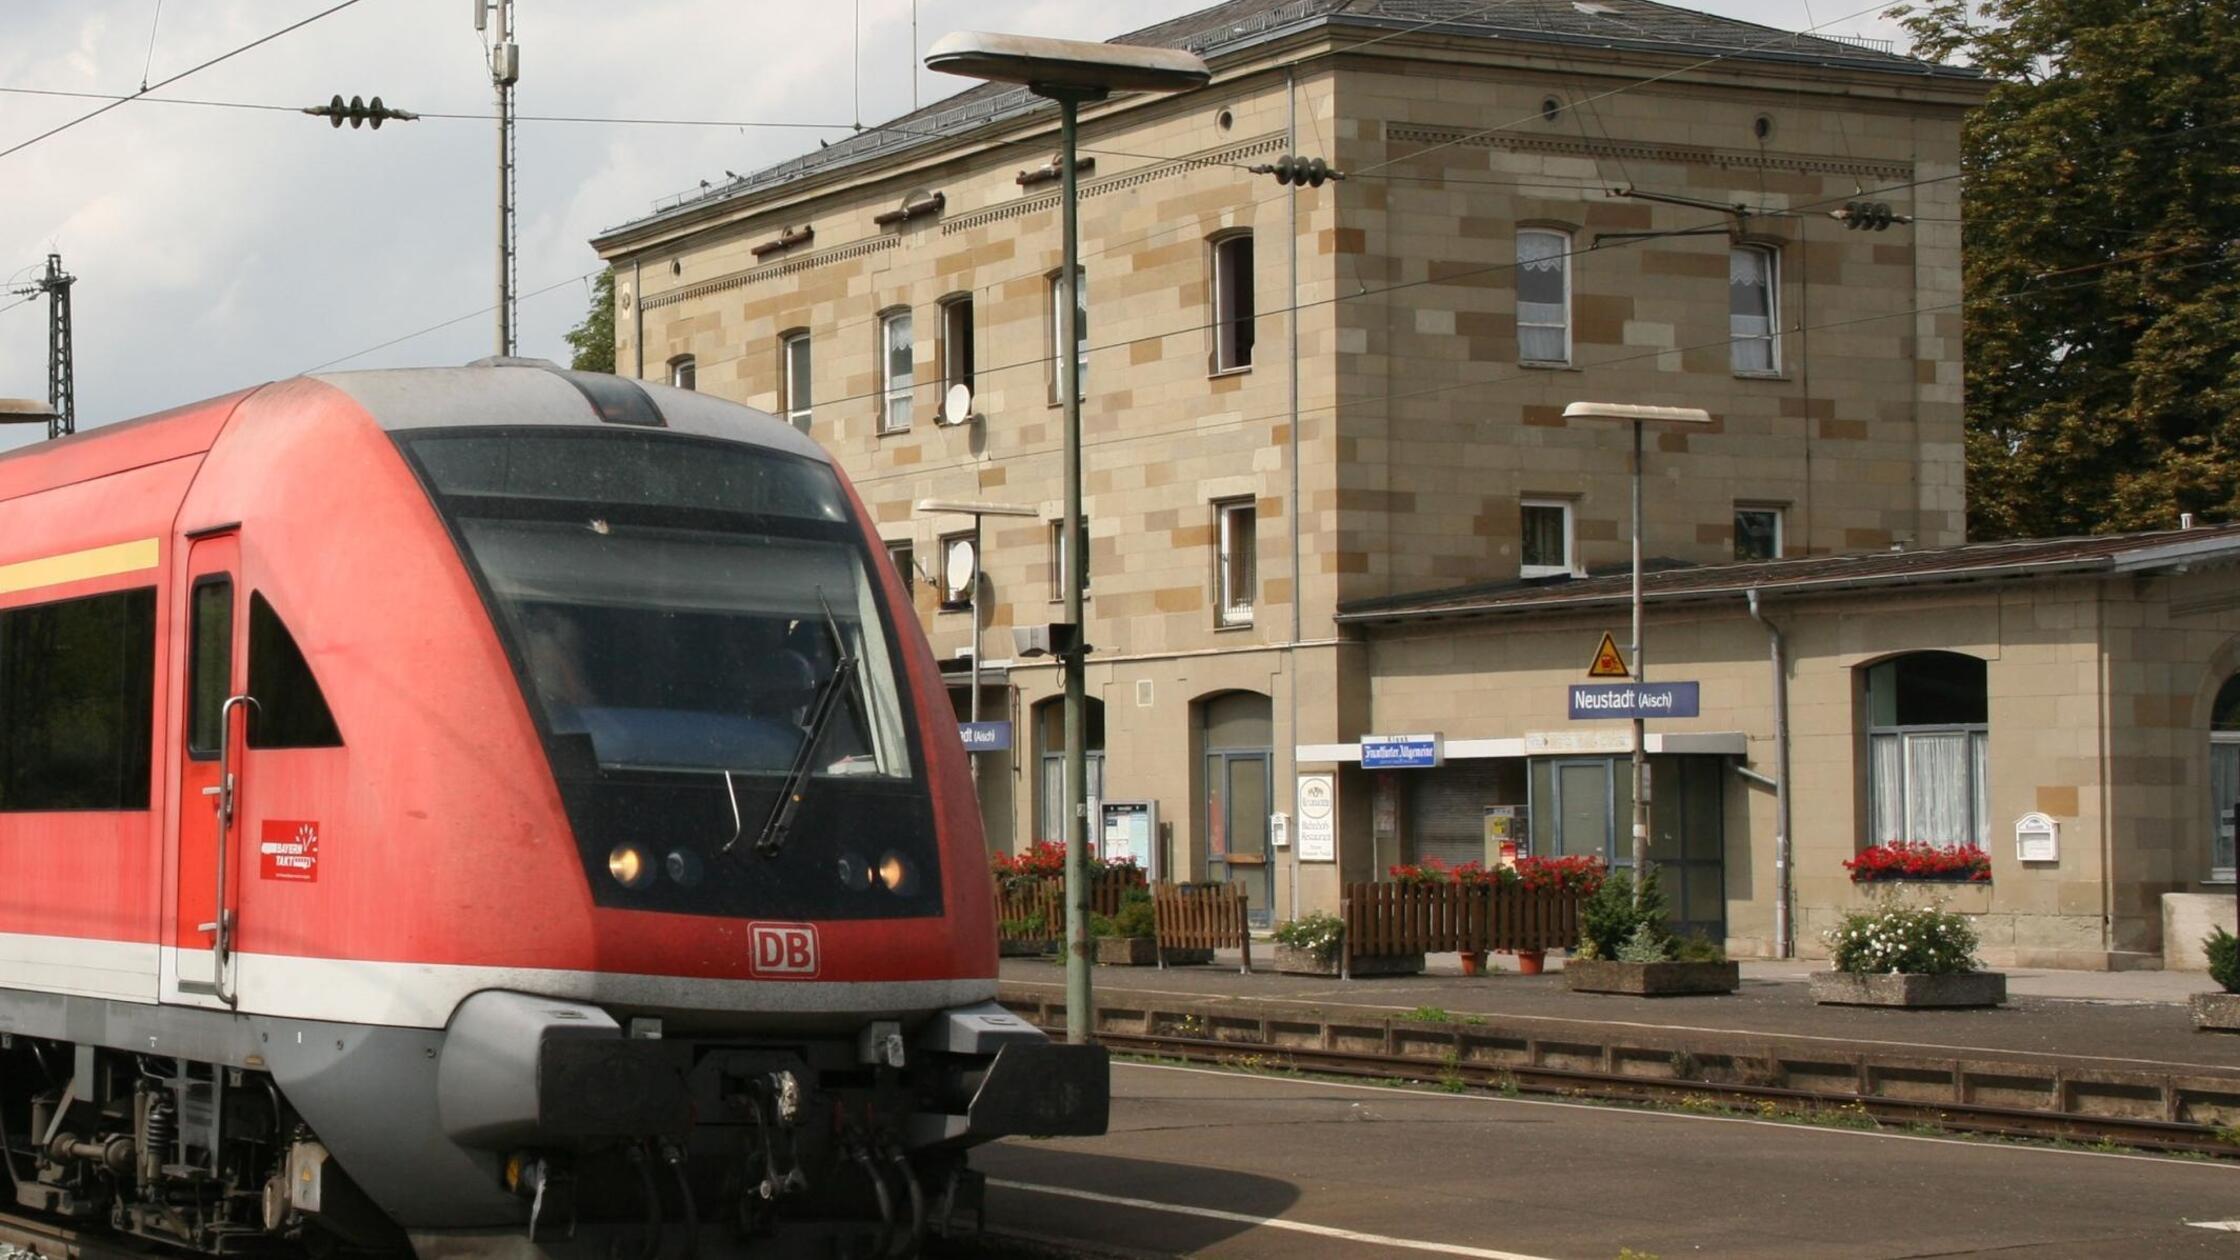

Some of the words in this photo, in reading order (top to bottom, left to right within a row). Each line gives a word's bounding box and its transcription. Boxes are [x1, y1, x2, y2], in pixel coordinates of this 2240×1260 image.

[1575, 689, 1636, 709] Neustadt
[1638, 690, 1673, 713] (Aisch)
[759, 931, 812, 968] DB
